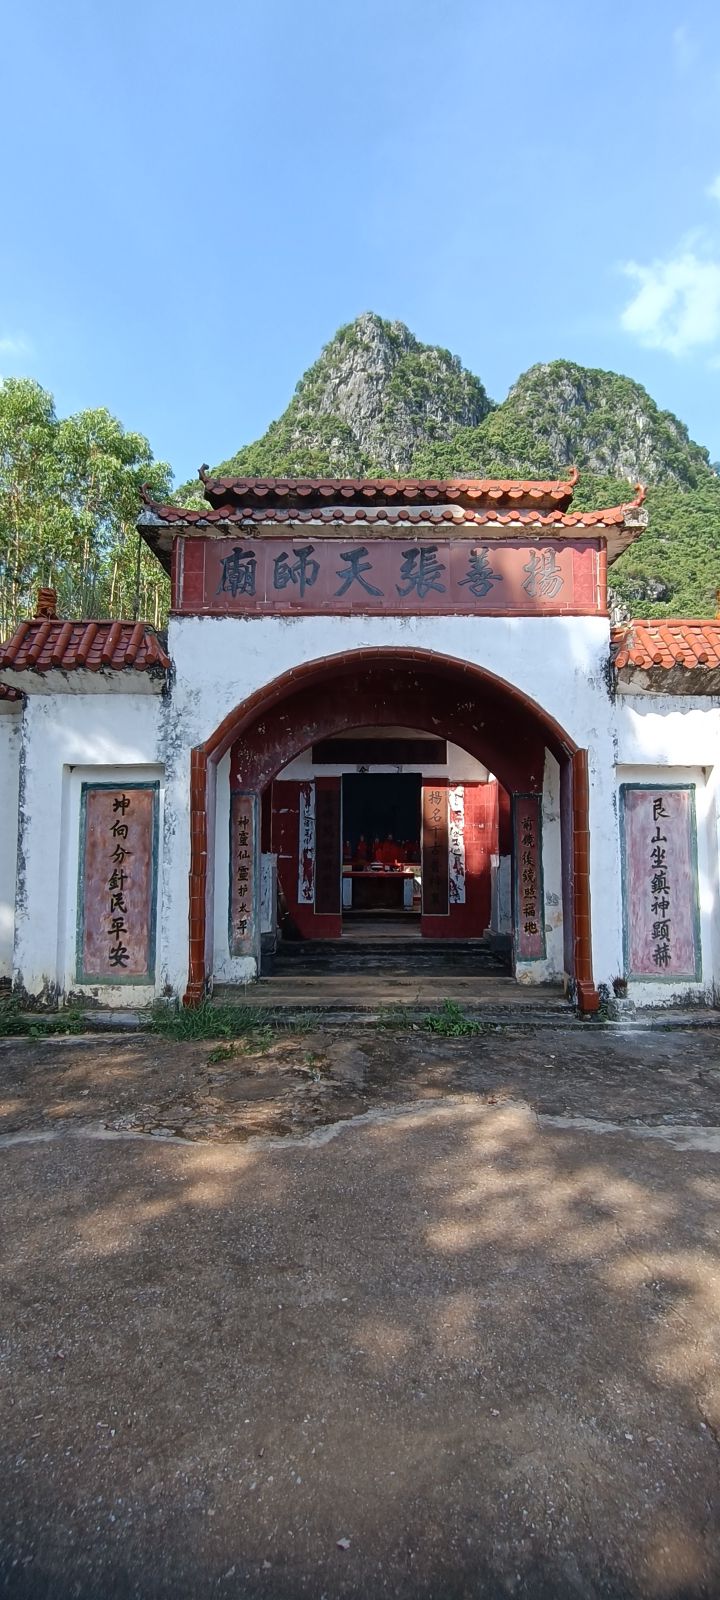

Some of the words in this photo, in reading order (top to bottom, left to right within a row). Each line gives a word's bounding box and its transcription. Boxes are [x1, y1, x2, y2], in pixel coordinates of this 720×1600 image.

[108, 794, 131, 967] 坤向分針民平安
